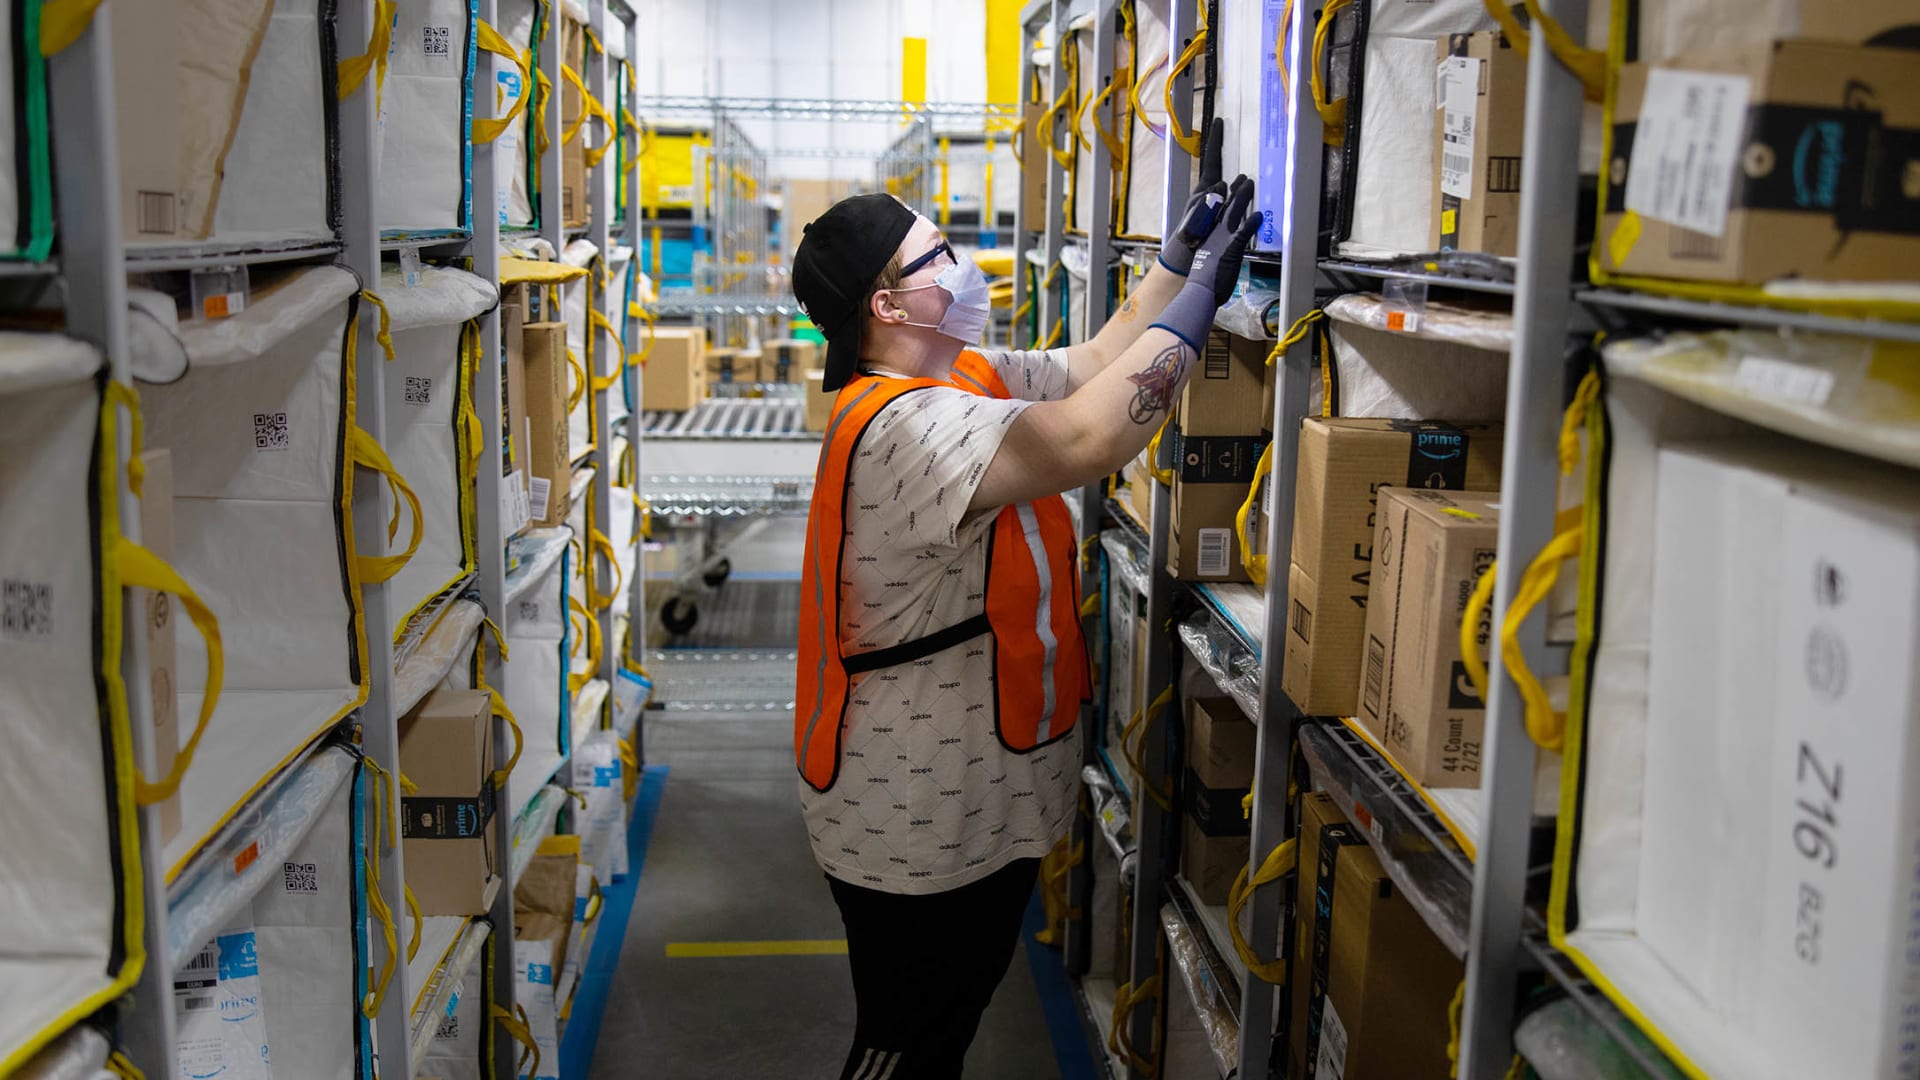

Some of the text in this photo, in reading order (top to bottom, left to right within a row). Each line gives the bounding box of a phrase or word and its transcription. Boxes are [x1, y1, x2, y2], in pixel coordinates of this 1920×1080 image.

[1417, 432, 1462, 447] prime
[968, 463, 983, 487] adidas
[1442, 718, 1464, 773] 44 Count
[1462, 742, 1480, 772] 2/22
[455, 804, 470, 836] prime
[1792, 739, 1843, 870] Z16
